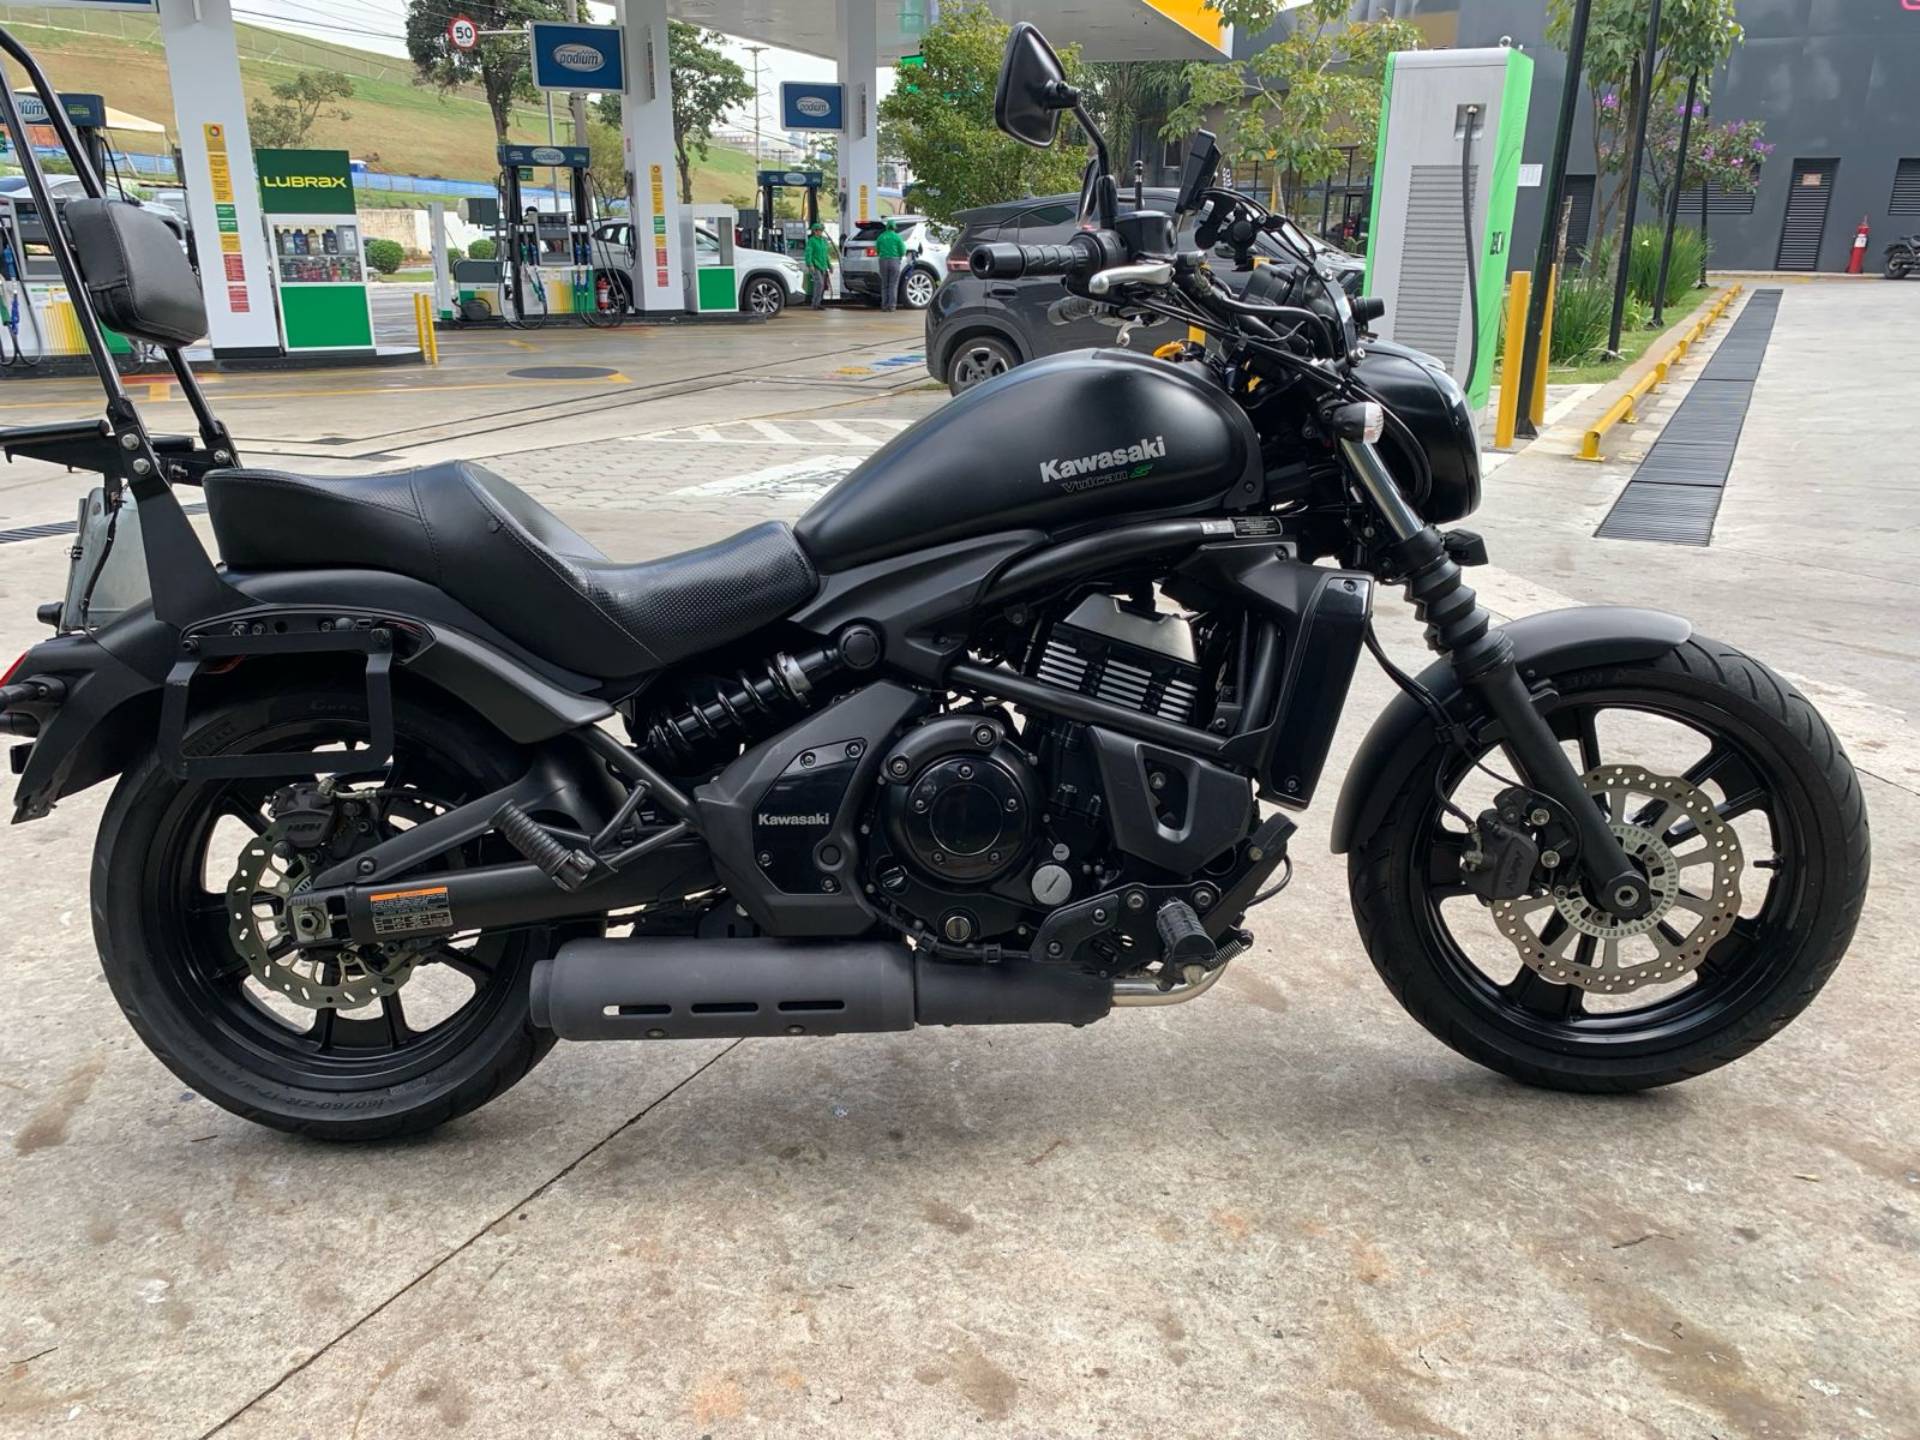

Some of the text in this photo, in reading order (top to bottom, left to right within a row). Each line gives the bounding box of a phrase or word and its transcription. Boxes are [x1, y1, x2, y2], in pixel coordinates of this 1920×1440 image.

[455, 26, 473, 39] 50
[559, 52, 599, 66] podium
[1039, 436, 1166, 483] Kawasaki
[758, 813, 829, 825] Kawasaki
